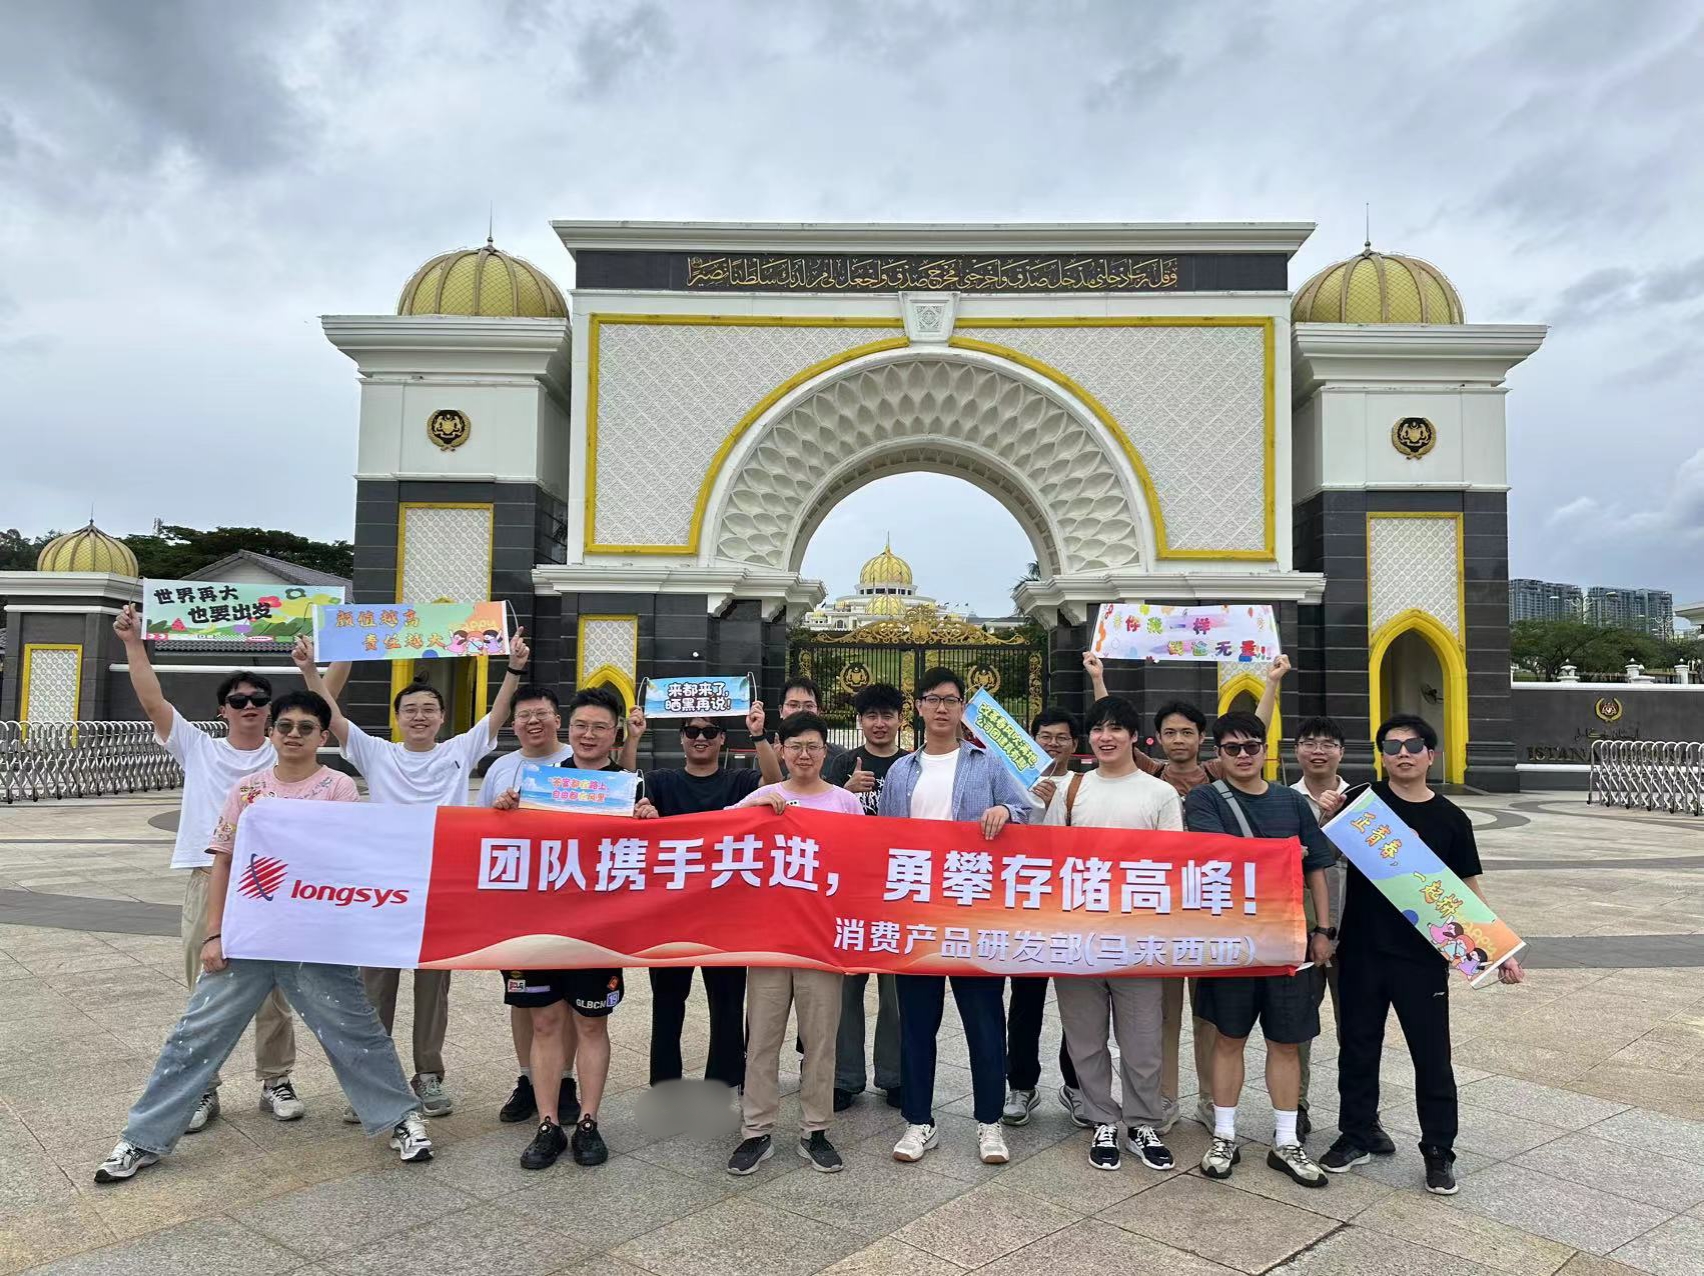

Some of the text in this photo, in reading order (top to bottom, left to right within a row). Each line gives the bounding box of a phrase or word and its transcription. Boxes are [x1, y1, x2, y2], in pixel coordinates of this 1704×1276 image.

[154, 585, 239, 605] 世界再大
[188, 602, 272, 624] 也要出发
[336, 609, 420, 628] 颜值越高
[363, 633, 446, 651] 责任越大
[668, 681, 729, 697] 来都来了，
[665, 696, 731, 712] 晒黑再说！
[477, 834, 1257, 914] 团队携手共进， 勇攀存储高峰！
[291, 879, 409, 908] longsys
[1413, 871, 1463, 919] 一起拼
[834, 917, 1256, 967] 消费产品研发部(马来西亚)
